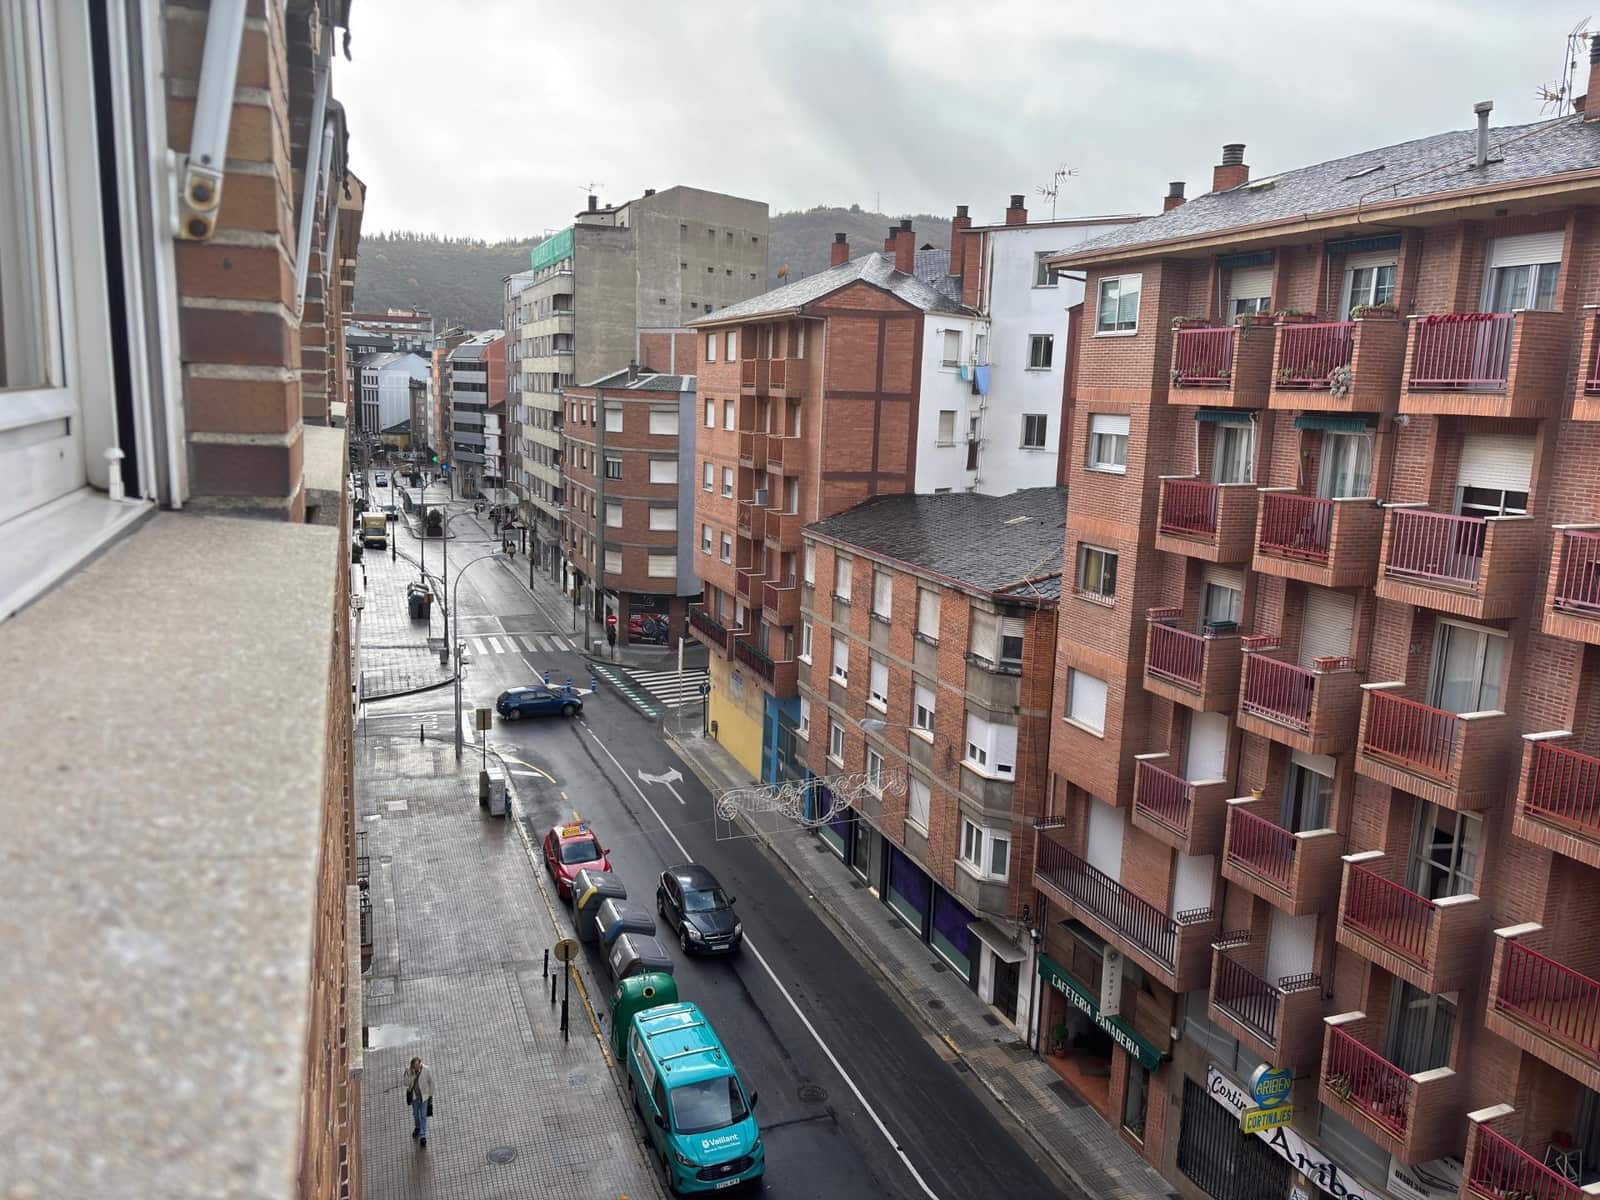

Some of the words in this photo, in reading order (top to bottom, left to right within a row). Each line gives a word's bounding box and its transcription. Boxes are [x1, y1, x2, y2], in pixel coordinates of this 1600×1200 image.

[1052, 974, 1092, 1017] CAFETERIA
[1256, 1078, 1292, 1096] ARIBEN
[1247, 1110, 1292, 1130] CORTINAJES
[708, 1134, 739, 1146] Vaillant
